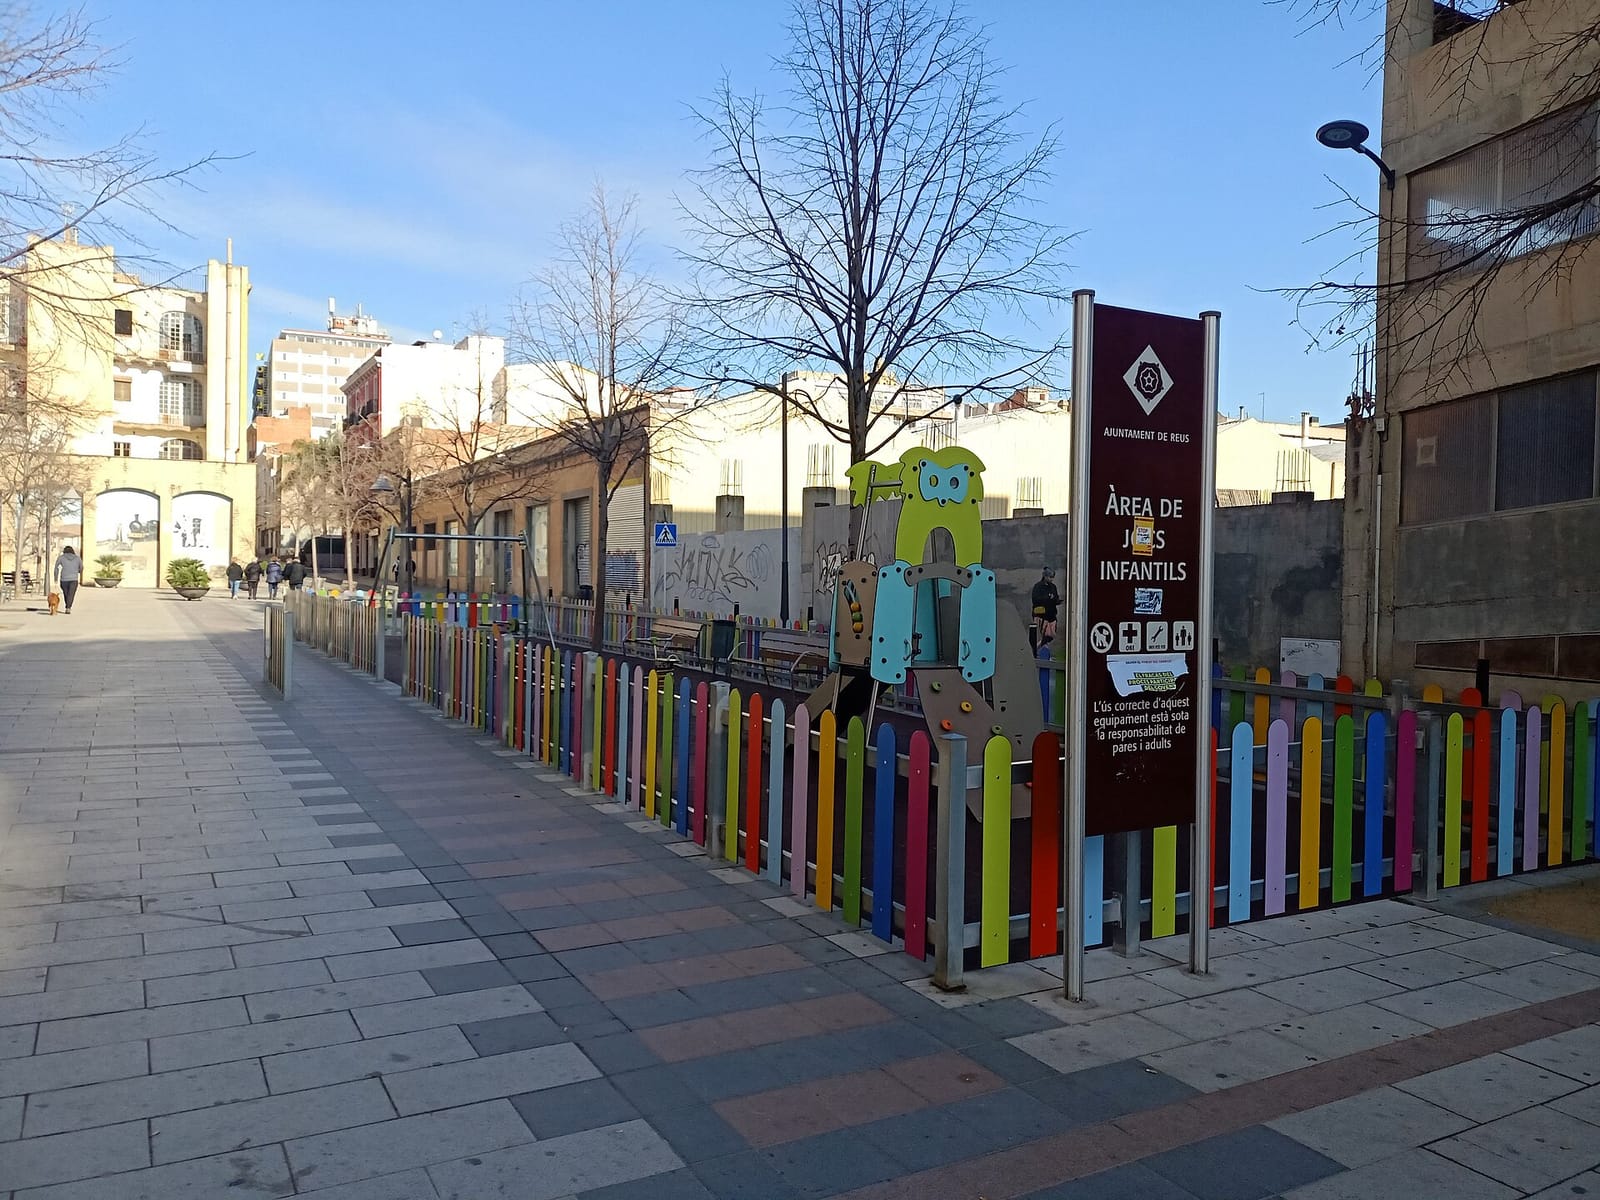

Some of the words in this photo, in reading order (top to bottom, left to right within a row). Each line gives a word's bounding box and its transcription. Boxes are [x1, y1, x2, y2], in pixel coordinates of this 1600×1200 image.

[1104, 427, 1155, 440] AJUNTAMENT
[1157, 432, 1168, 441] DE
[1170, 433, 1189, 443] REUS
[1105, 484, 1153, 517] ÀREA
[1160, 498, 1182, 518] DE
[1122, 529, 1166, 549] JS
[1100, 560, 1187, 581] INFANTILS
[1114, 699, 1150, 711] correcte
[1152, 696, 1190, 711] d'aquest
[1093, 712, 1149, 730] equipament
[1151, 710, 1169, 723] està
[1171, 711, 1189, 721] sota
[1096, 728, 1105, 740] la
[1108, 723, 1173, 742] responsabilitat
[1174, 722, 1186, 734] de
[1112, 742, 1137, 757] pares
[1139, 739, 1143, 751] i
[1145, 737, 1172, 750] adults
